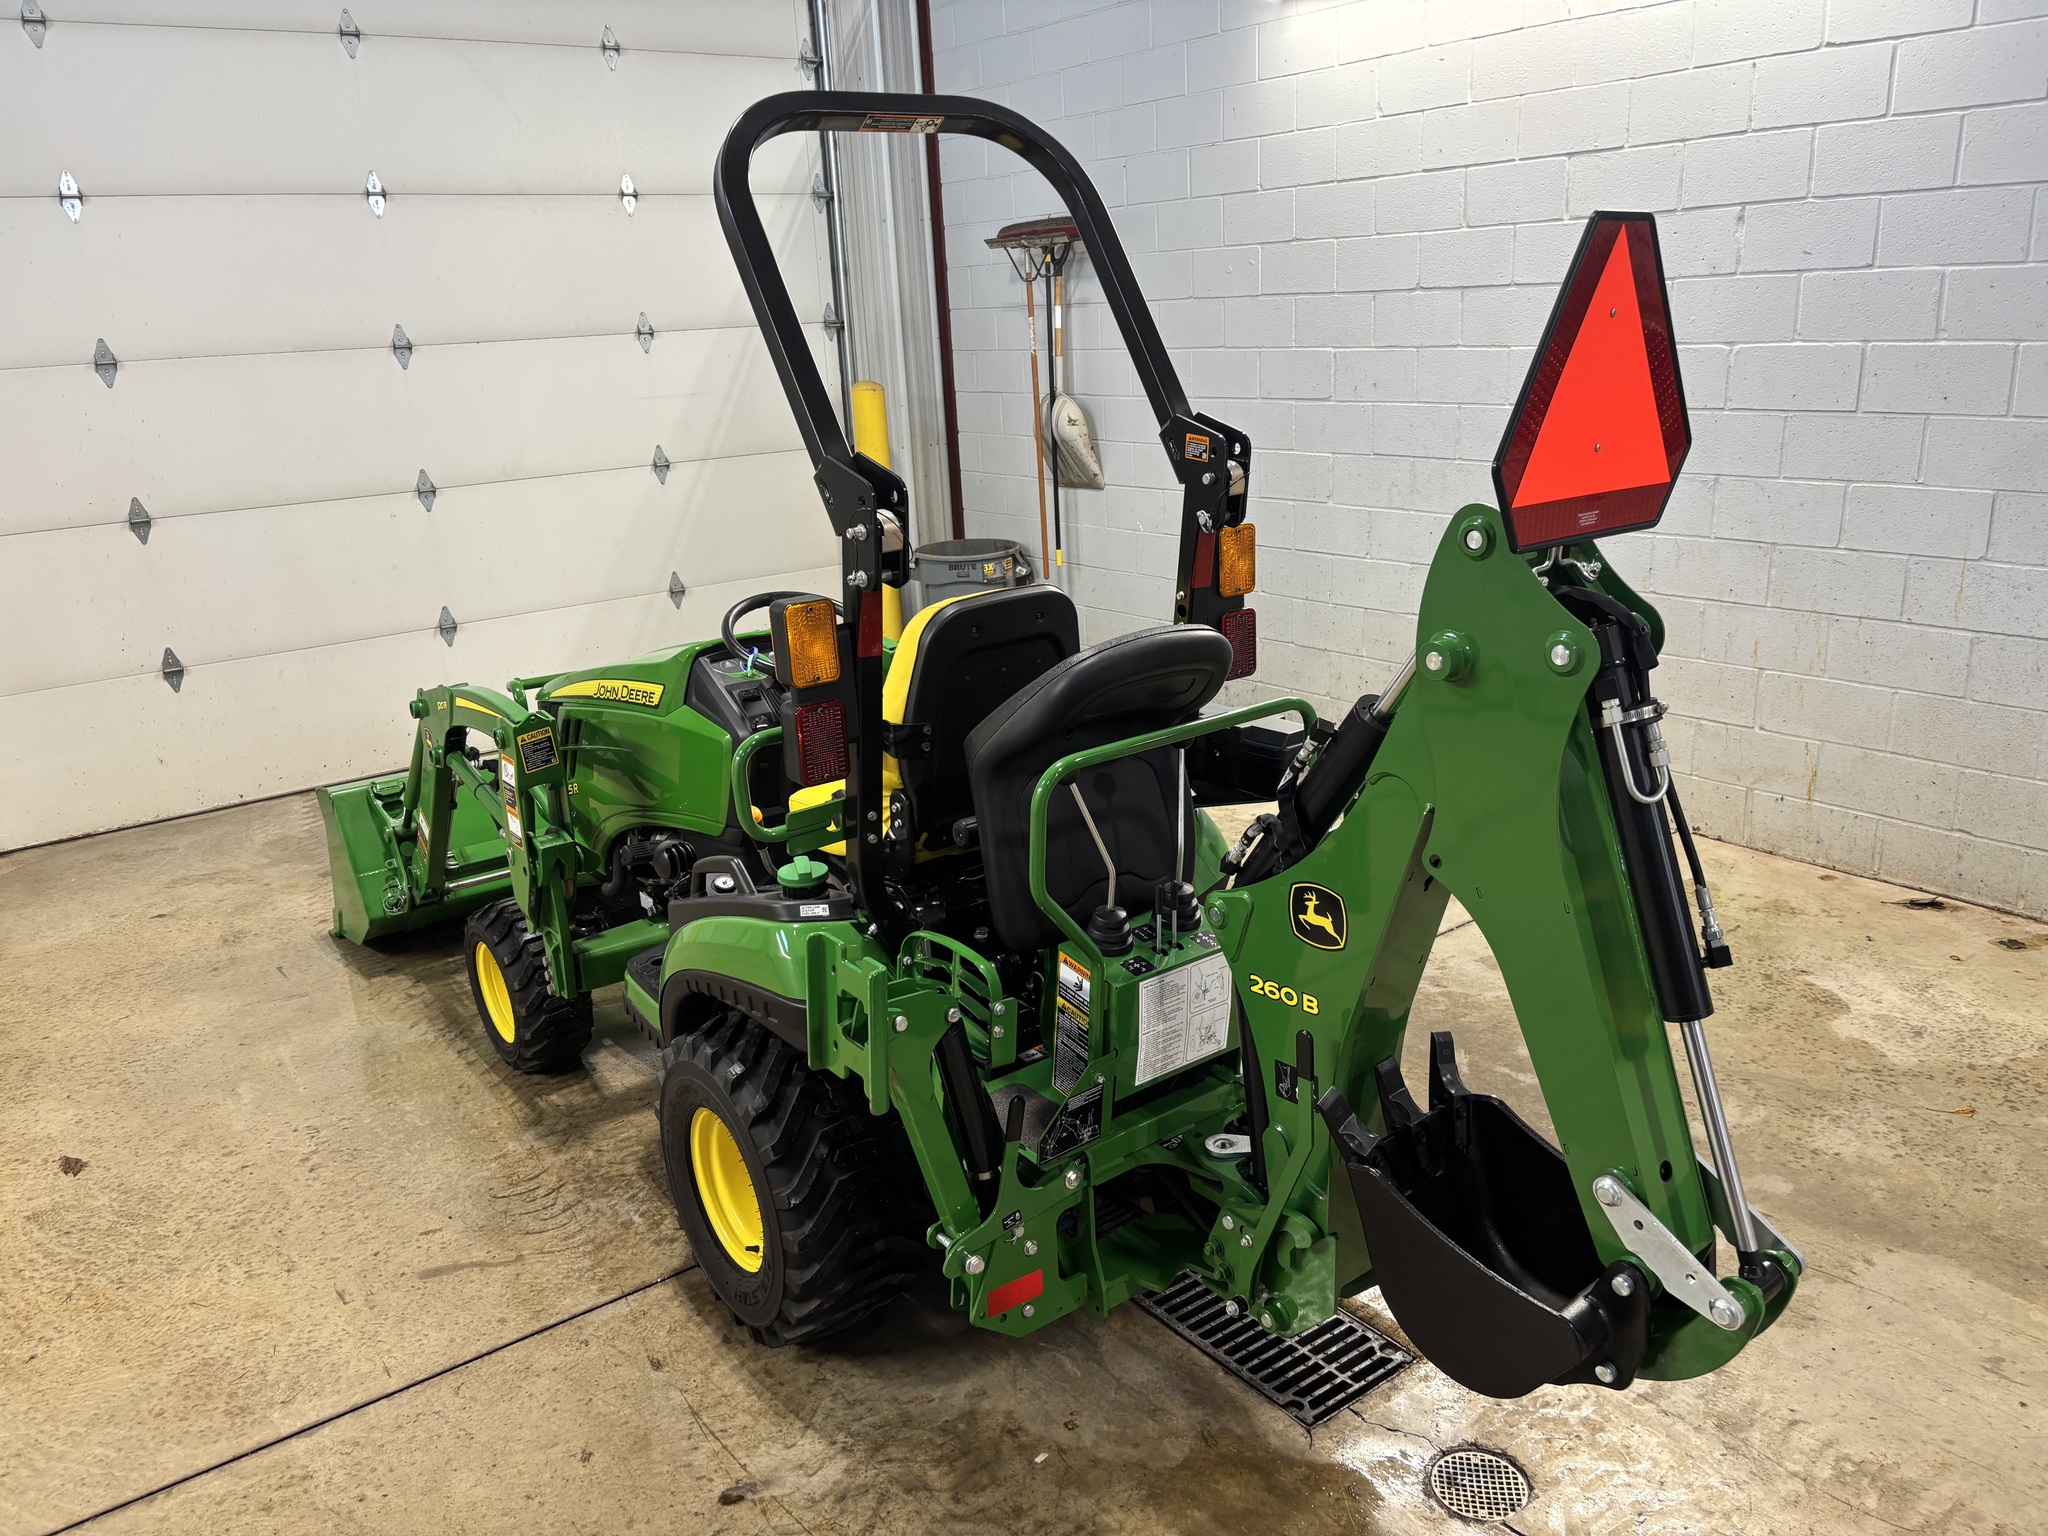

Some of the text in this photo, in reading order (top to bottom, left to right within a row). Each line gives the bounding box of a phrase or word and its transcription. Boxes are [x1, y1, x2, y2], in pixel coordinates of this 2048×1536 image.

[948, 563, 977, 571] BRUTE
[983, 563, 994, 572] 3X
[594, 683, 656, 704] JOHN DEERE
[526, 728, 550, 741] CAUTION
[1068, 960, 1090, 981] WARNIN
[1249, 973, 1299, 1007] 260
[1302, 992, 1320, 1016] B
[1066, 1006, 1089, 1026] CAUTIO
